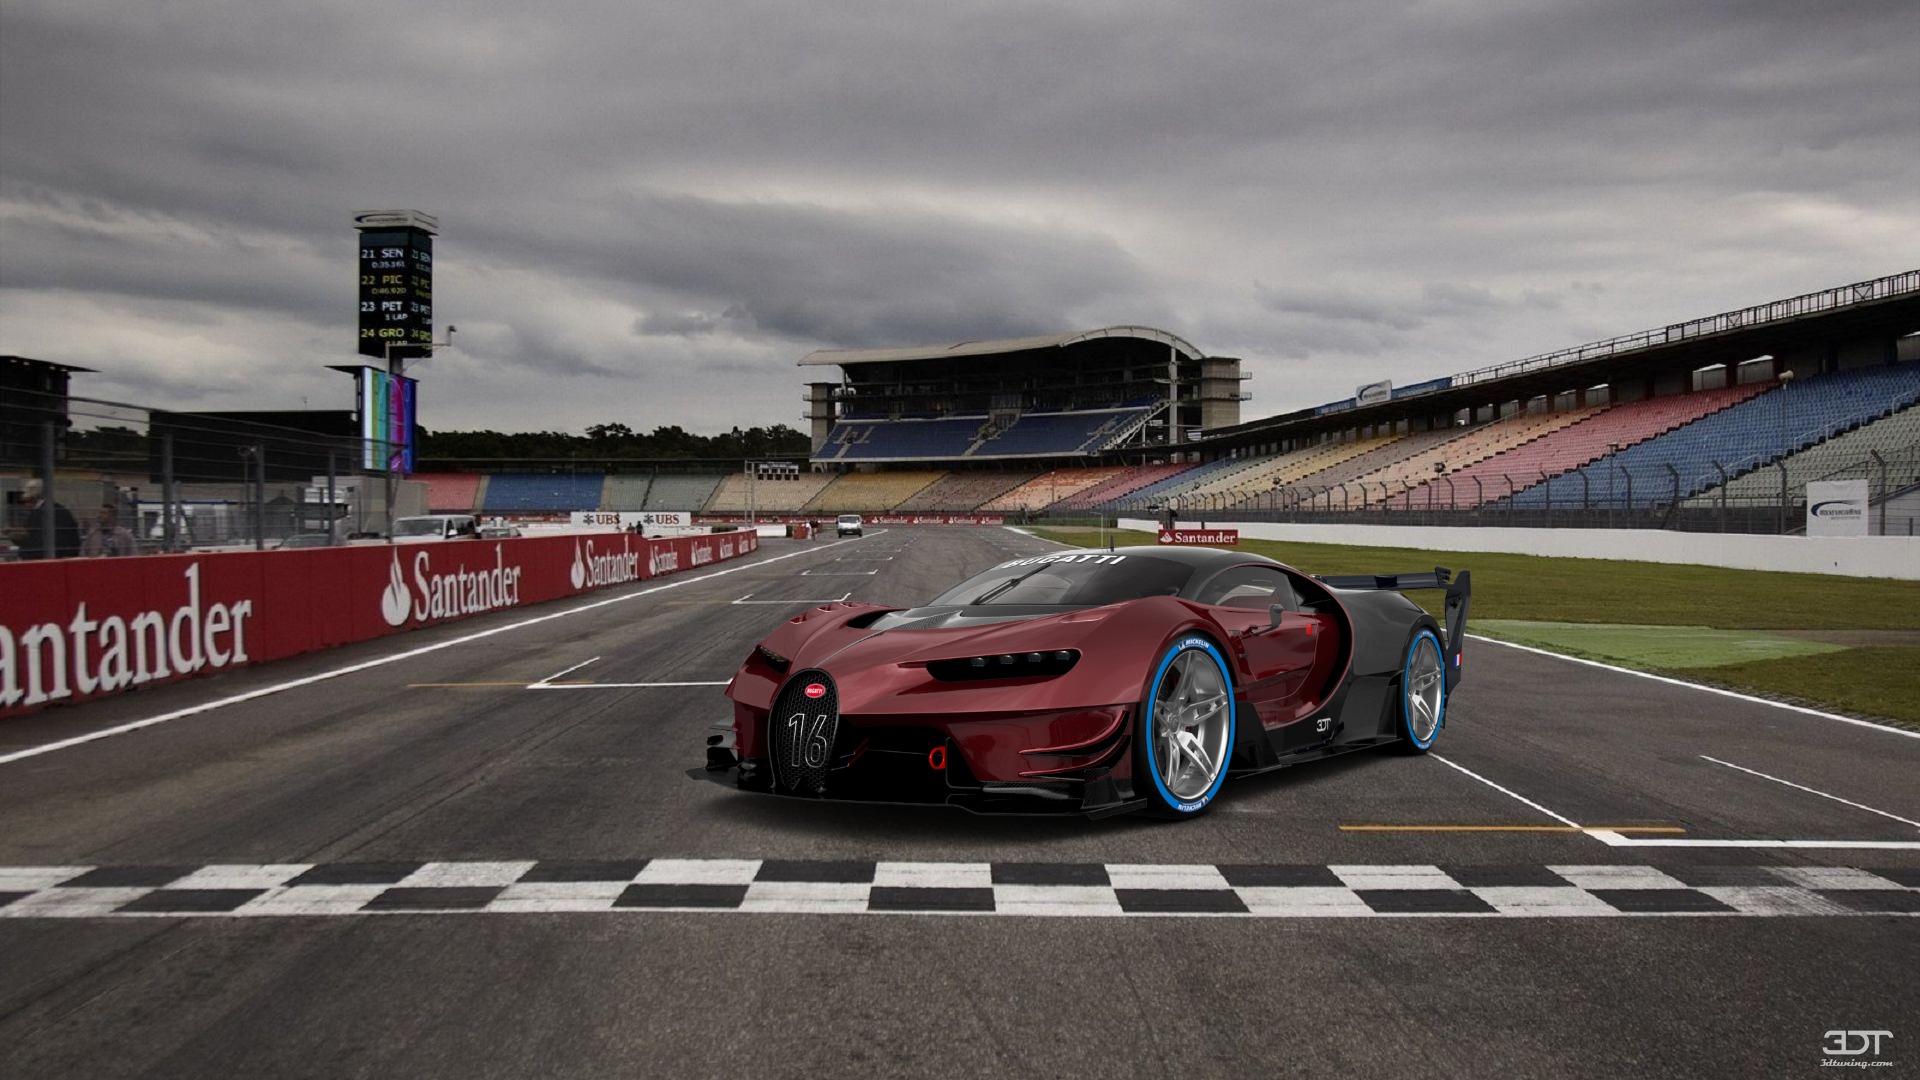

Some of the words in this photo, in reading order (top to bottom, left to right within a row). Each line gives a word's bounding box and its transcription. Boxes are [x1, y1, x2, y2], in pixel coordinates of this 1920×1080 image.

[361, 250, 375, 258] 21
[381, 248, 403, 258] SEN
[361, 275, 375, 284] 22
[382, 275, 403, 284] PIC
[361, 301, 375, 311] 23
[382, 301, 403, 311] PET
[361, 329, 375, 337] 24
[379, 328, 405, 337] GRO
[596, 514, 619, 524] UBS
[656, 514, 680, 525] UBS
[1175, 531, 1236, 544] Santander
[586, 534, 640, 587] Santander
[1001, 554, 1127, 569] BUGATTI
[414, 543, 521, 622] Santander
[1316, 718, 1331, 732] 3DT
[788, 713, 828, 768] 16
